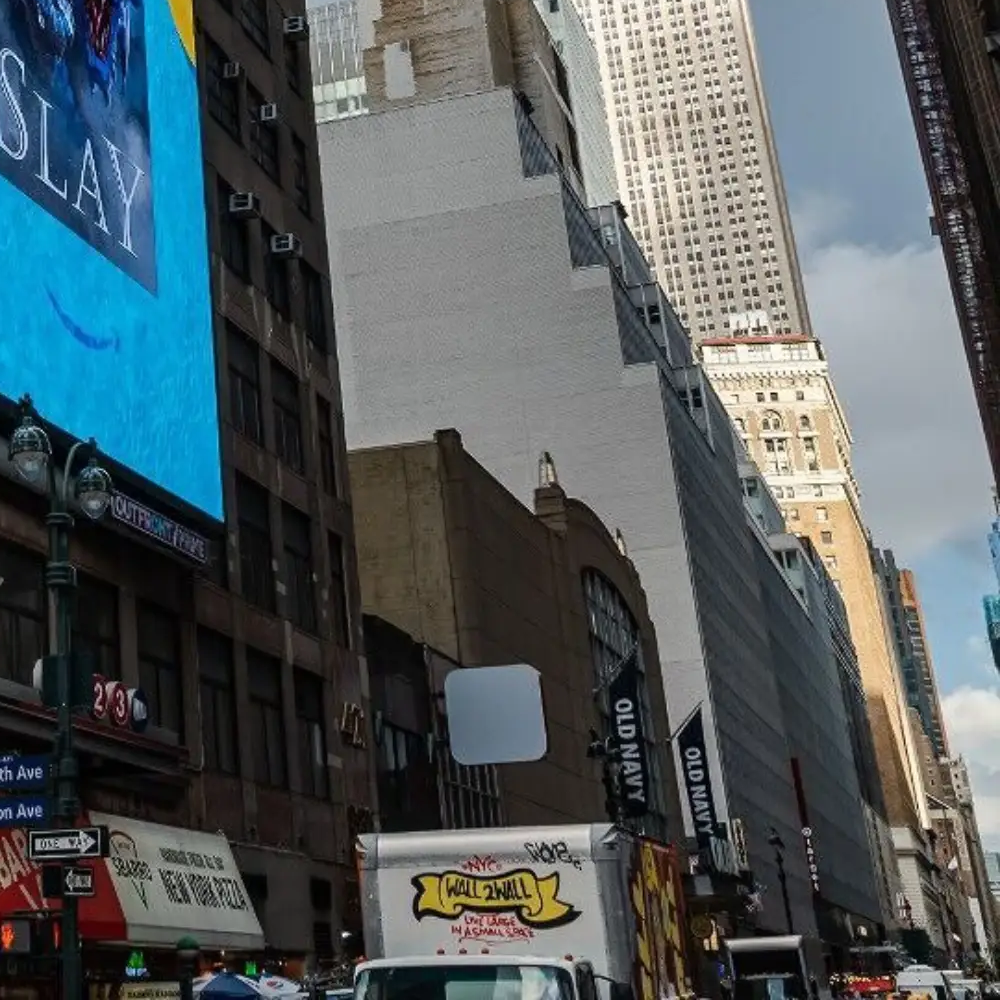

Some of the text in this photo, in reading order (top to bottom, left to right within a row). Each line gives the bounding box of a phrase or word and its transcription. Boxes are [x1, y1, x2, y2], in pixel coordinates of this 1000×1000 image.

[94, 681, 125, 718] 2 3
[615, 697, 646, 803] OLD NAVY
[16, 764, 43, 780] Ave
[685, 747, 714, 834] OLD NAVY
[16, 803, 43, 819] Ave
[40, 840, 60, 850] ONE
